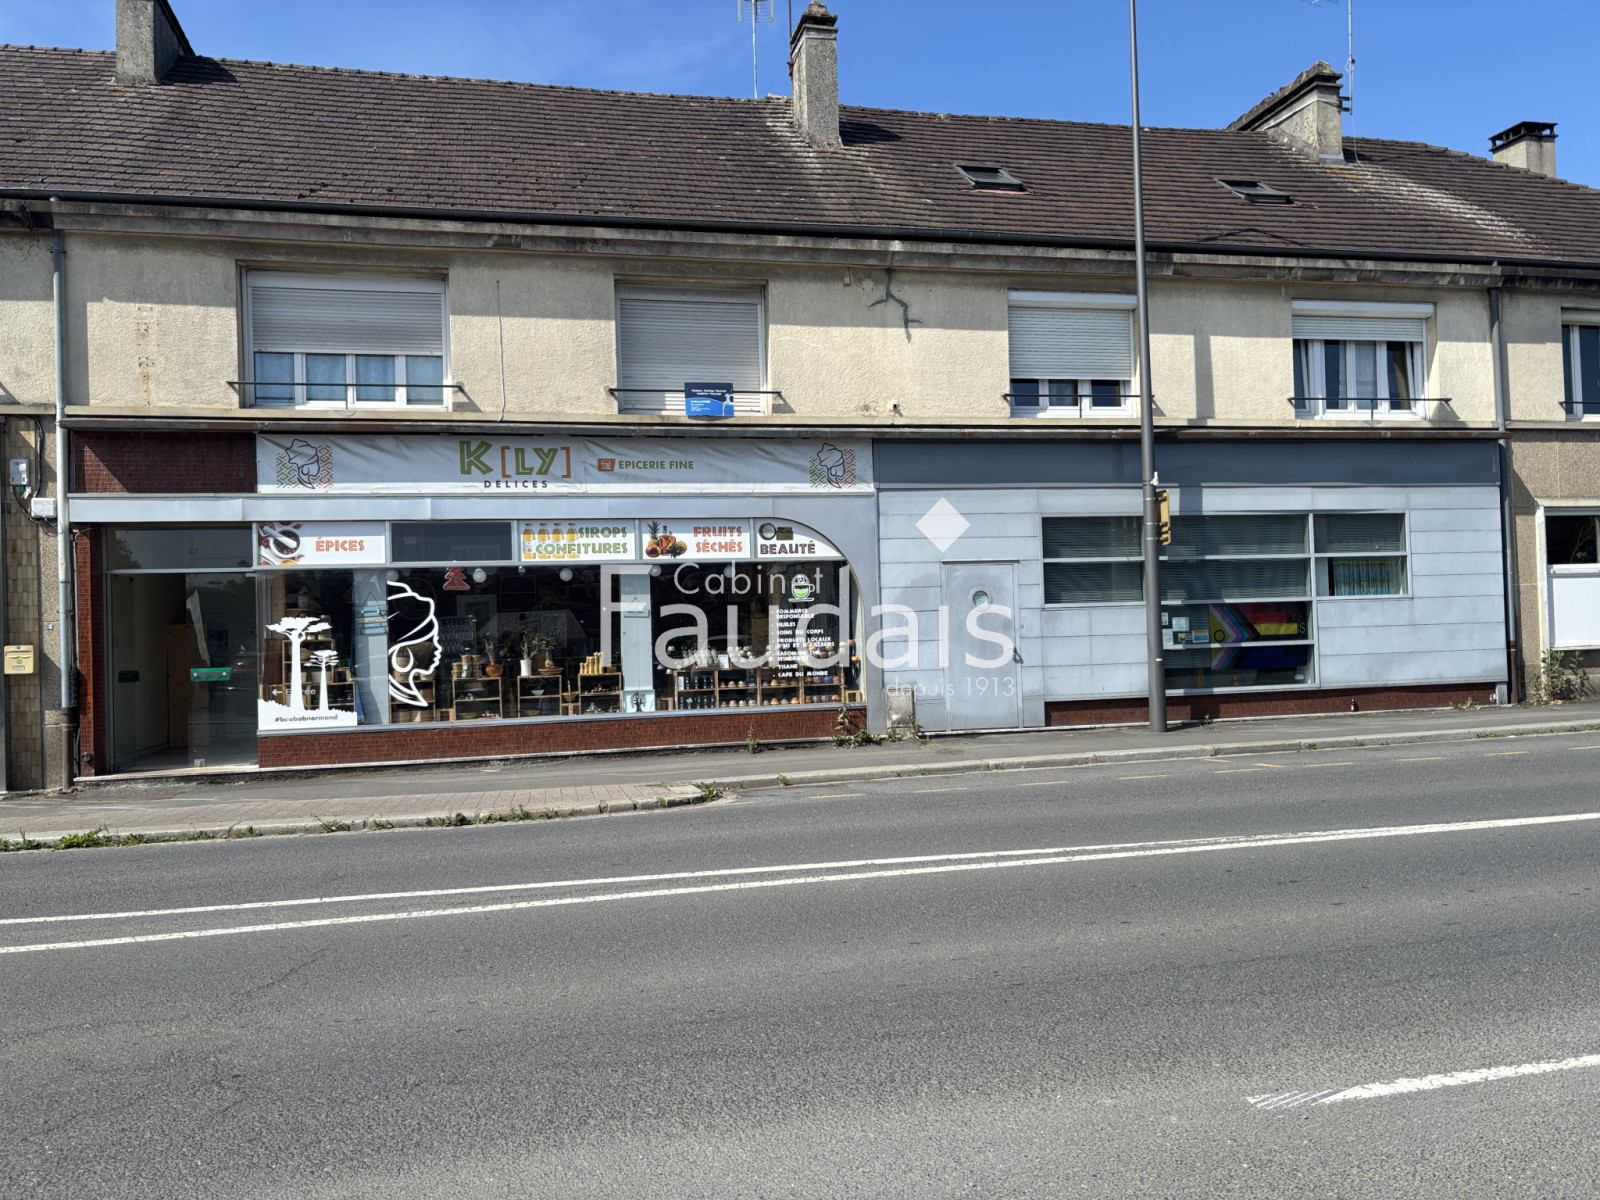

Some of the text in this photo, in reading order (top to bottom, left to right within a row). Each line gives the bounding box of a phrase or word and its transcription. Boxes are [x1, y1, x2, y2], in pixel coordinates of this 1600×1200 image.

[618, 458, 694, 469] ÉPICERIE FINE
[484, 479, 547, 488] DÉLICES
[578, 527, 627, 538] SIROPS
[693, 526, 742, 537] FRUITS
[315, 536, 365, 552] ÉPICES
[535, 543, 627, 554] CONFITURES
[695, 539, 742, 553] SÉCHÉS
[760, 540, 816, 554] BEAUTÉ
